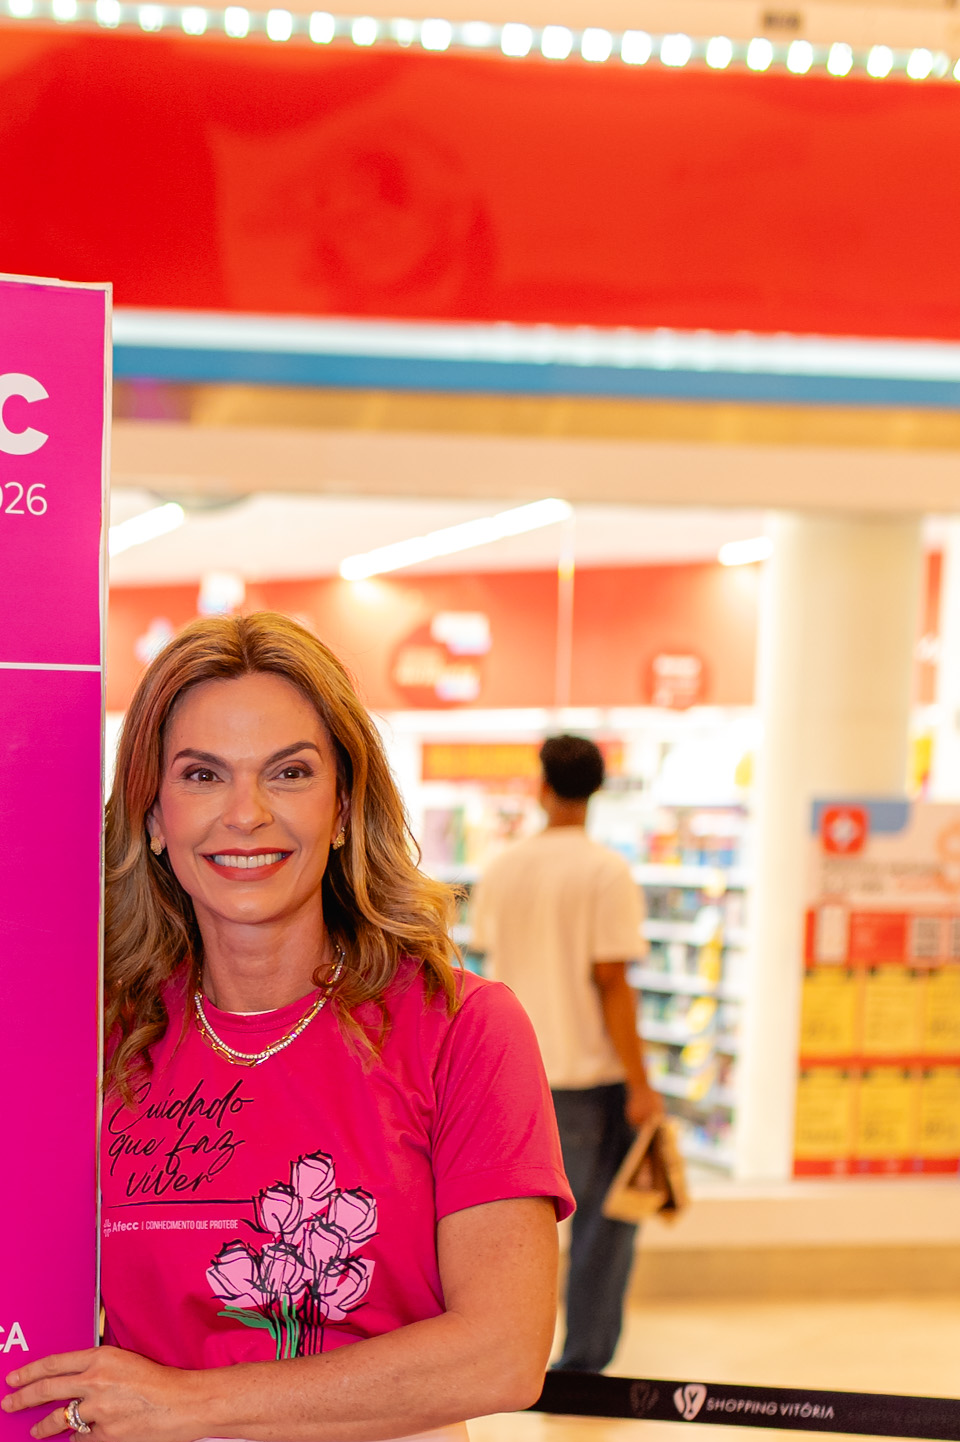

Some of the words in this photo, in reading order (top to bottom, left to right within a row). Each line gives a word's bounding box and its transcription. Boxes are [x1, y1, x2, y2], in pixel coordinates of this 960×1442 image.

[108, 1079, 254, 1135] Cuidado
[108, 1133, 166, 1177] que
[165, 1120, 246, 1176] faz
[126, 1164, 214, 1197] viver
[112, 1220, 139, 1233] Afecc
[145, 1220, 195, 1231] CONHECIMENTO
[195, 1219, 208, 1230] QUE
[209, 1219, 238, 1230] PROTEGE
[706, 1397, 778, 1416] SHOPPING
